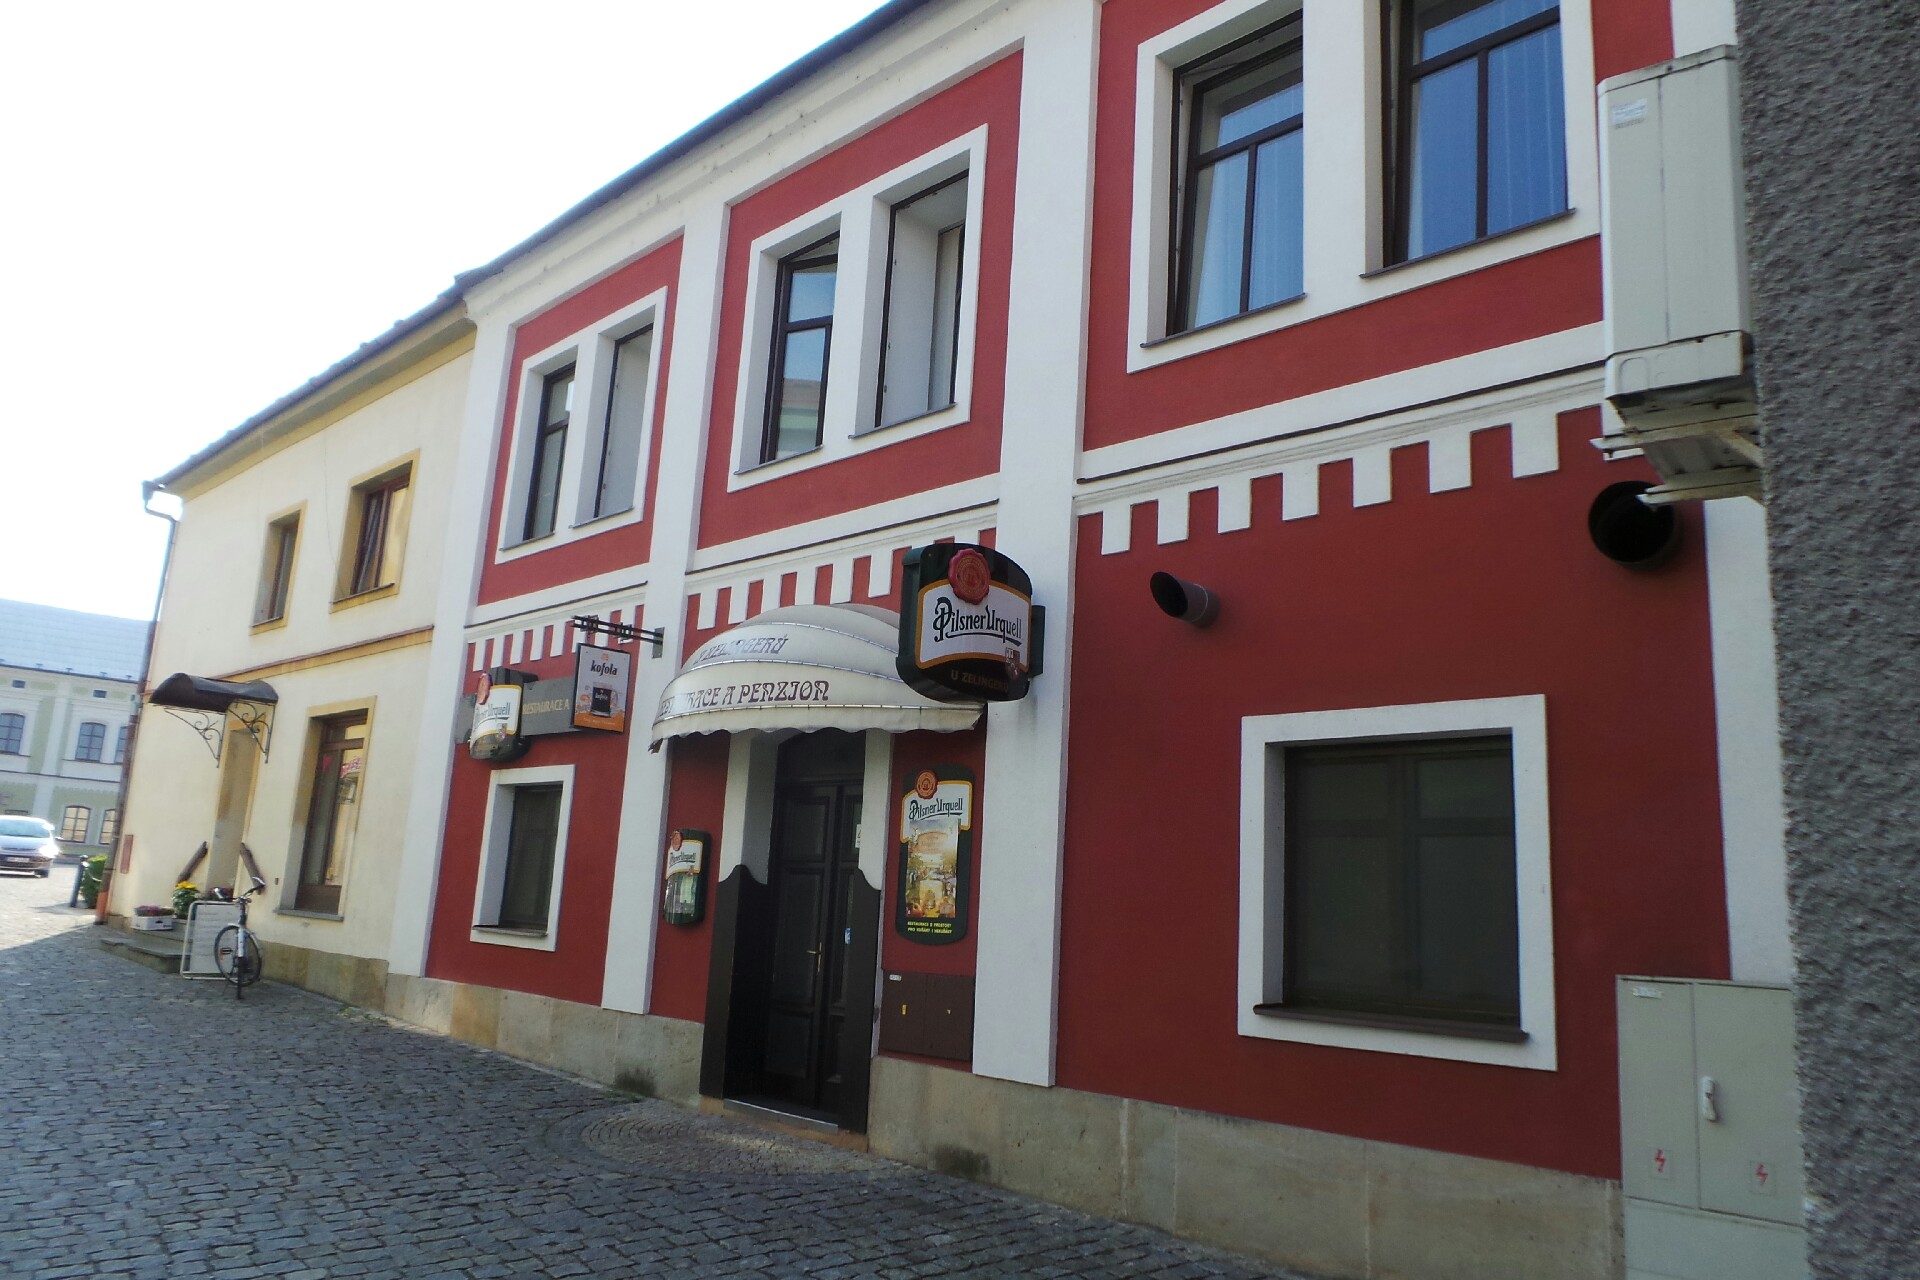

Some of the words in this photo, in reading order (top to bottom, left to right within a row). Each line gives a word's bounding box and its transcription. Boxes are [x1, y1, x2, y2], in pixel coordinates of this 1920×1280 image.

[933, 597, 986, 642] Pilsner
[985, 604, 1022, 644] Urquell
[591, 660, 617, 676] kofola
[950, 669, 959, 681] U
[721, 685, 736, 706] A
[909, 800, 937, 821] Pilsner
[936, 798, 963, 817] Urquell
